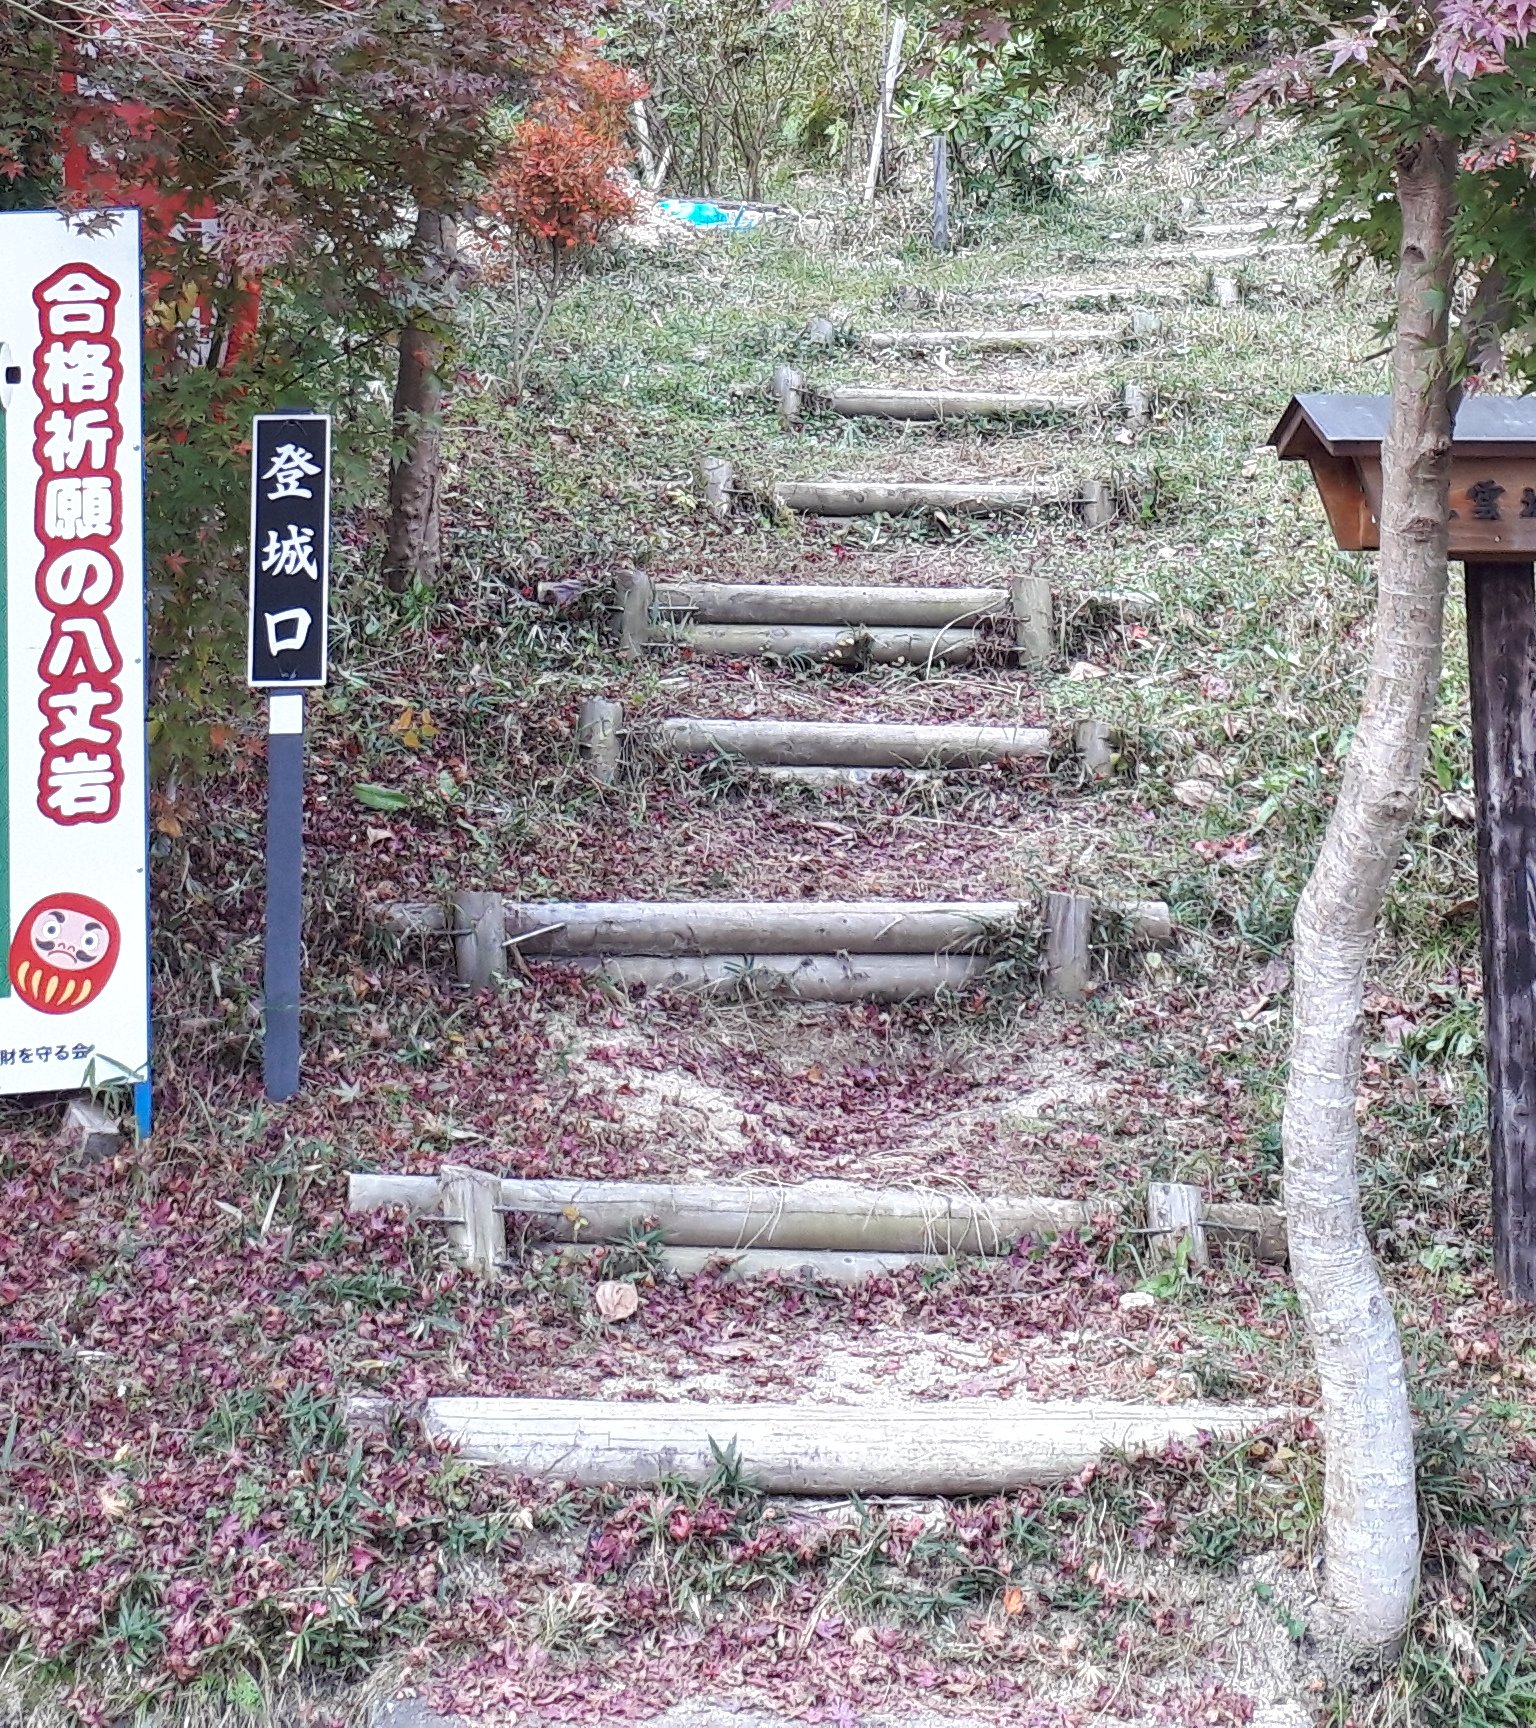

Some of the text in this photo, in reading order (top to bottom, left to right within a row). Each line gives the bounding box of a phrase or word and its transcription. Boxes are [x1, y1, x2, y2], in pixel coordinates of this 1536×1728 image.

[36, 264, 121, 824] 合格祈願の八丈岩
[261, 443, 322, 657] 登城口
